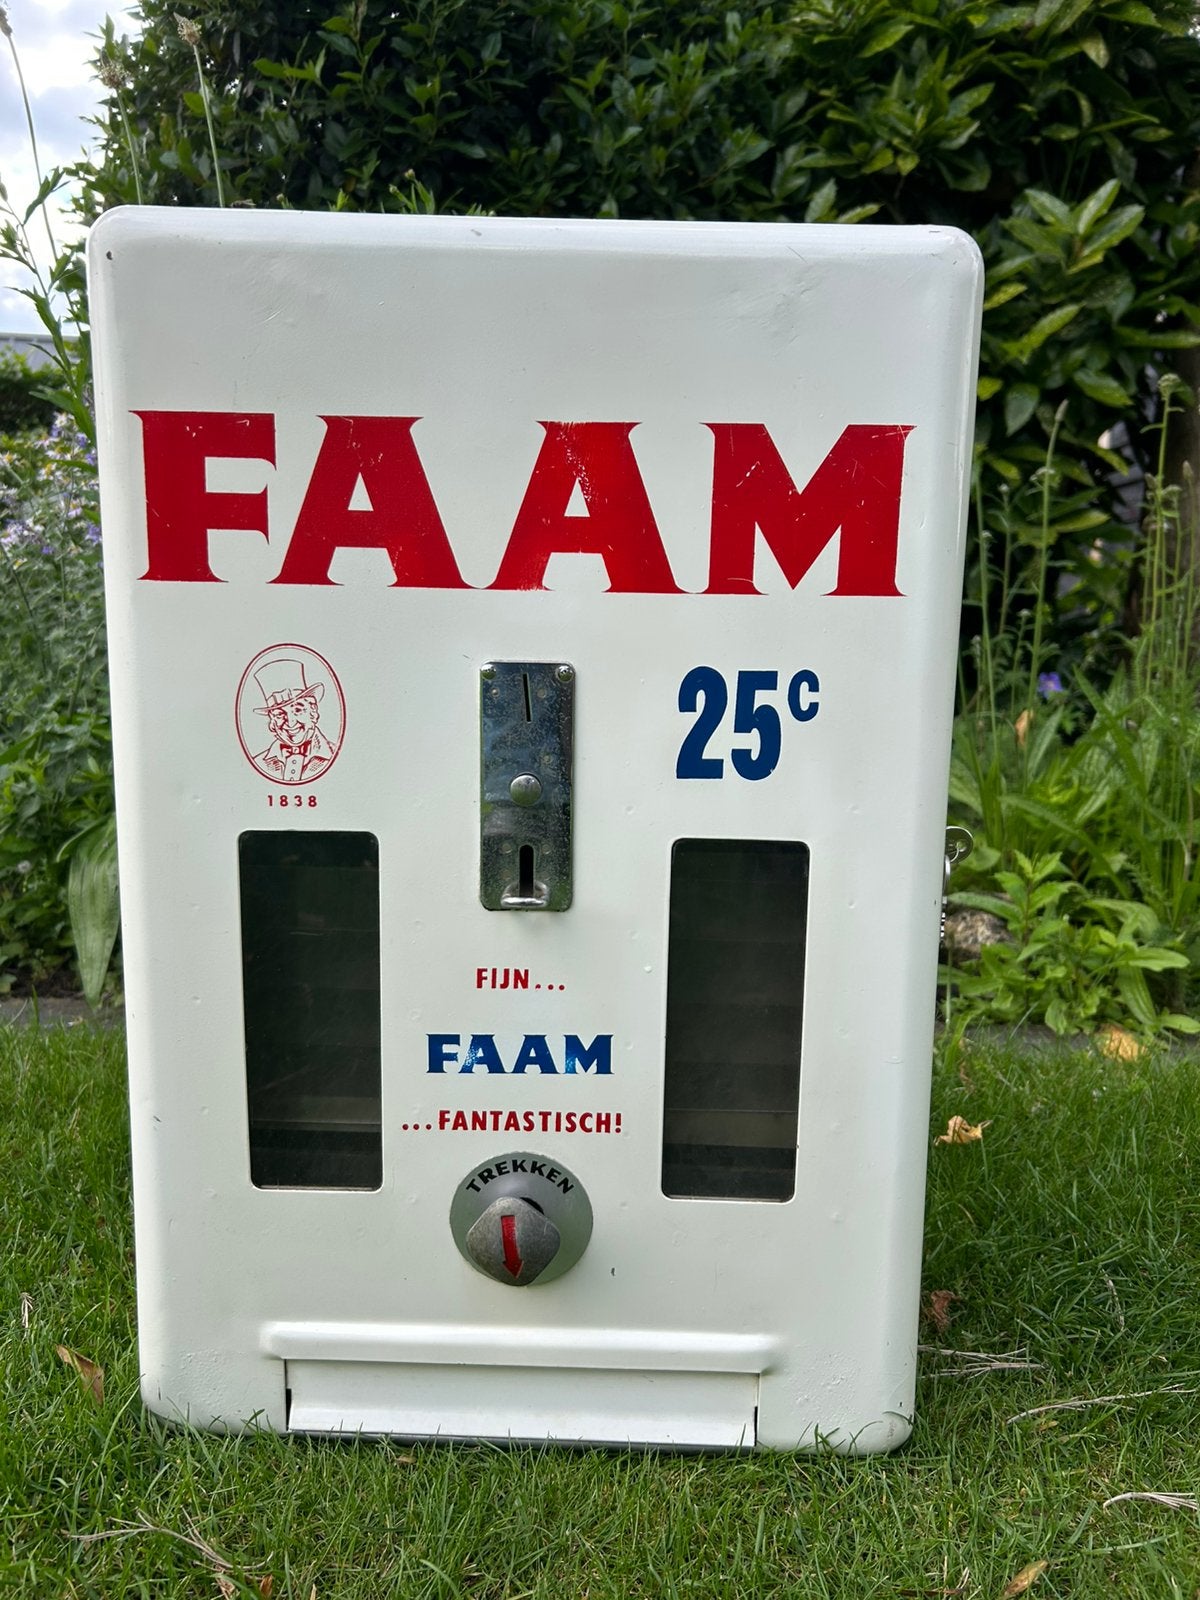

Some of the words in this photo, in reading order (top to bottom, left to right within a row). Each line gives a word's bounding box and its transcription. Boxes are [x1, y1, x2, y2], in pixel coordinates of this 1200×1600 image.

[130, 410, 915, 597] FAAM
[267, 795, 318, 808] 1838
[426, 1033, 614, 1075] FAAM
[402, 1109, 623, 1134] ...FANTASTISCH!
[465, 1159, 575, 1195] TREKKEN
